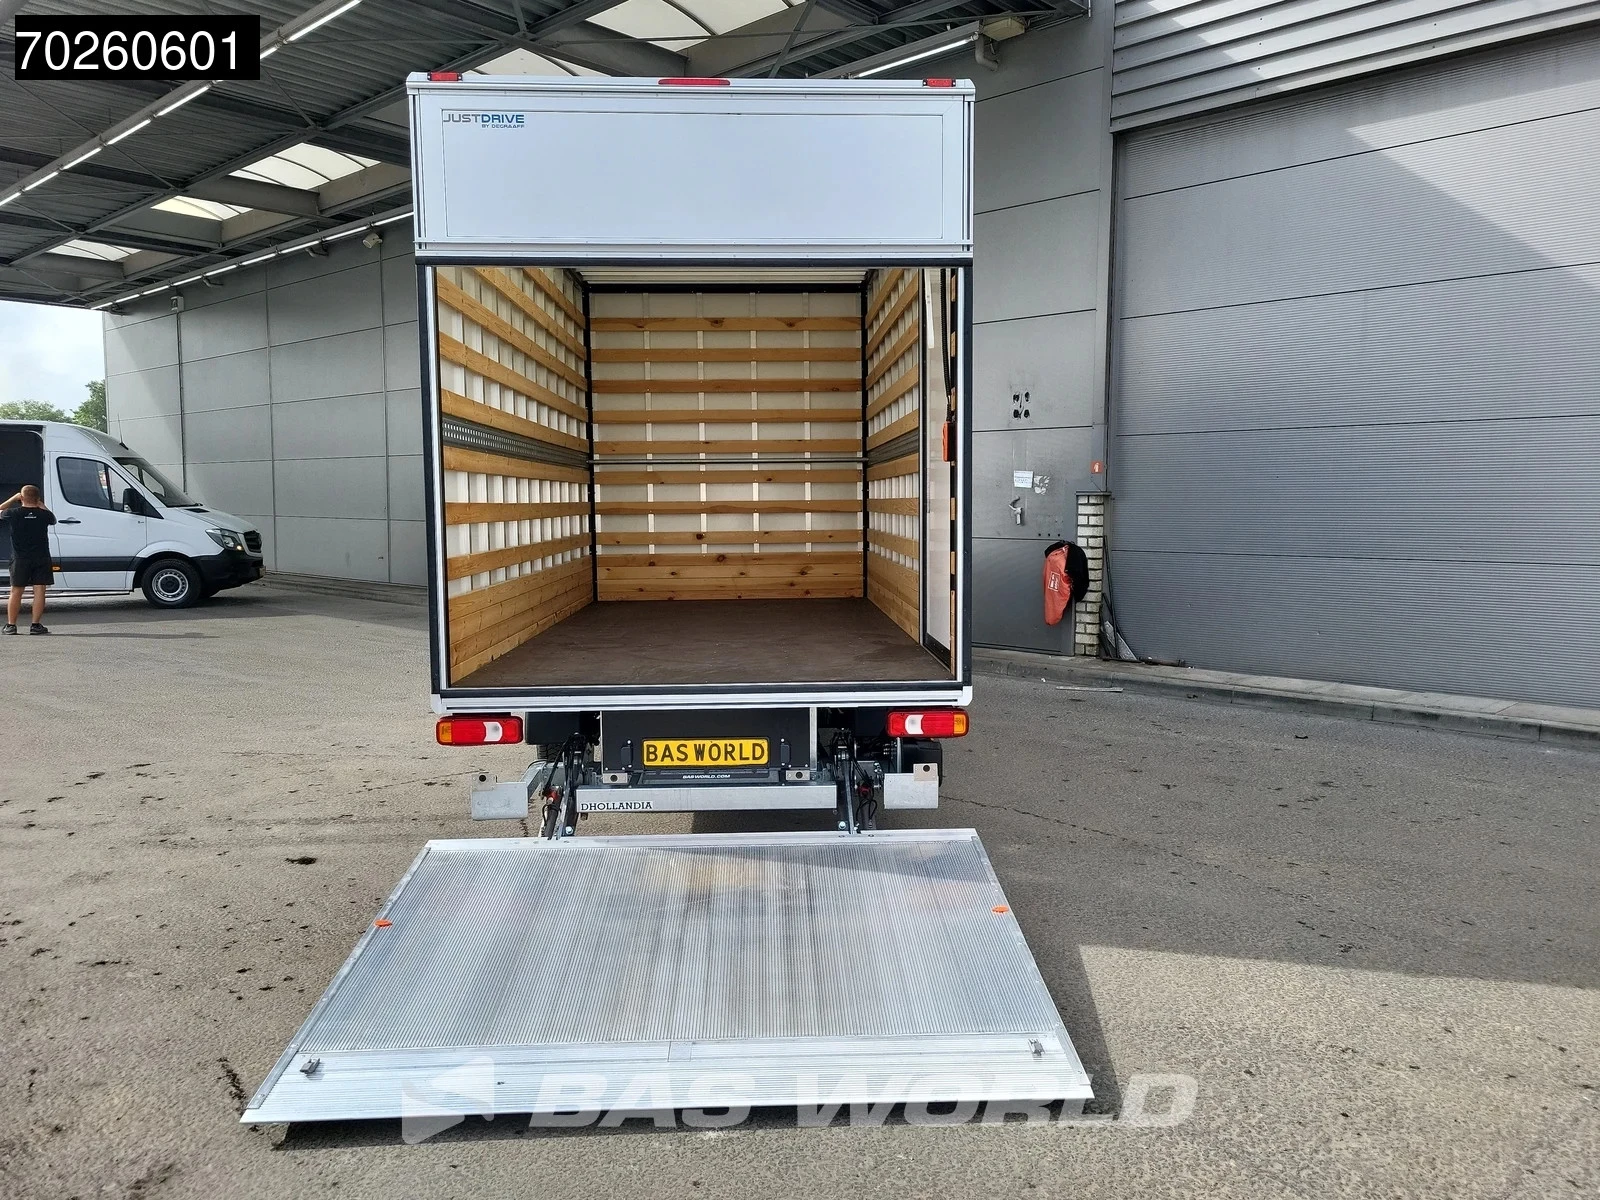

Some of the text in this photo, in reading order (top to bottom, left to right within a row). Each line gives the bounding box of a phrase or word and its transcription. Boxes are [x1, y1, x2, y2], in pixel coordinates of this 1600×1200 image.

[443, 113, 525, 123] JUSTDRIVE
[646, 743, 765, 762] BAS WORLD
[580, 802, 653, 811] DHOLLANDIA
